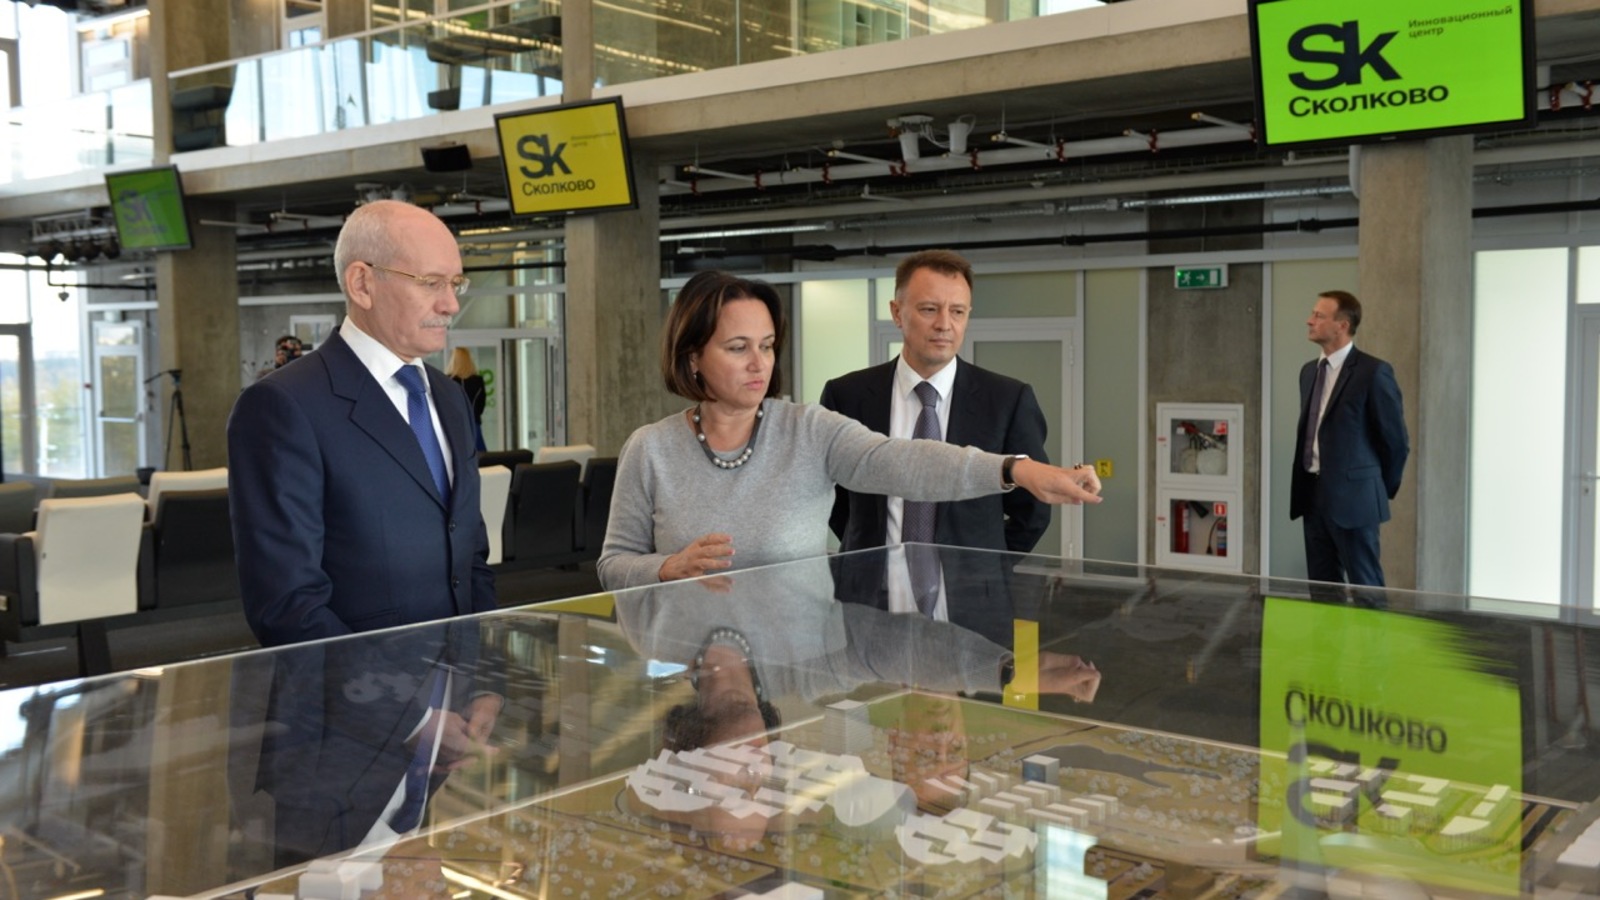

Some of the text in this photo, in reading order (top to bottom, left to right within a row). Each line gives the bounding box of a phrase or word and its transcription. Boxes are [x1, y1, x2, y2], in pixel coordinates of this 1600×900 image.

[1408, 5, 1513, 28] Инновационный
[1408, 27, 1444, 39] центр
[1287, 19, 1403, 91] Sk
